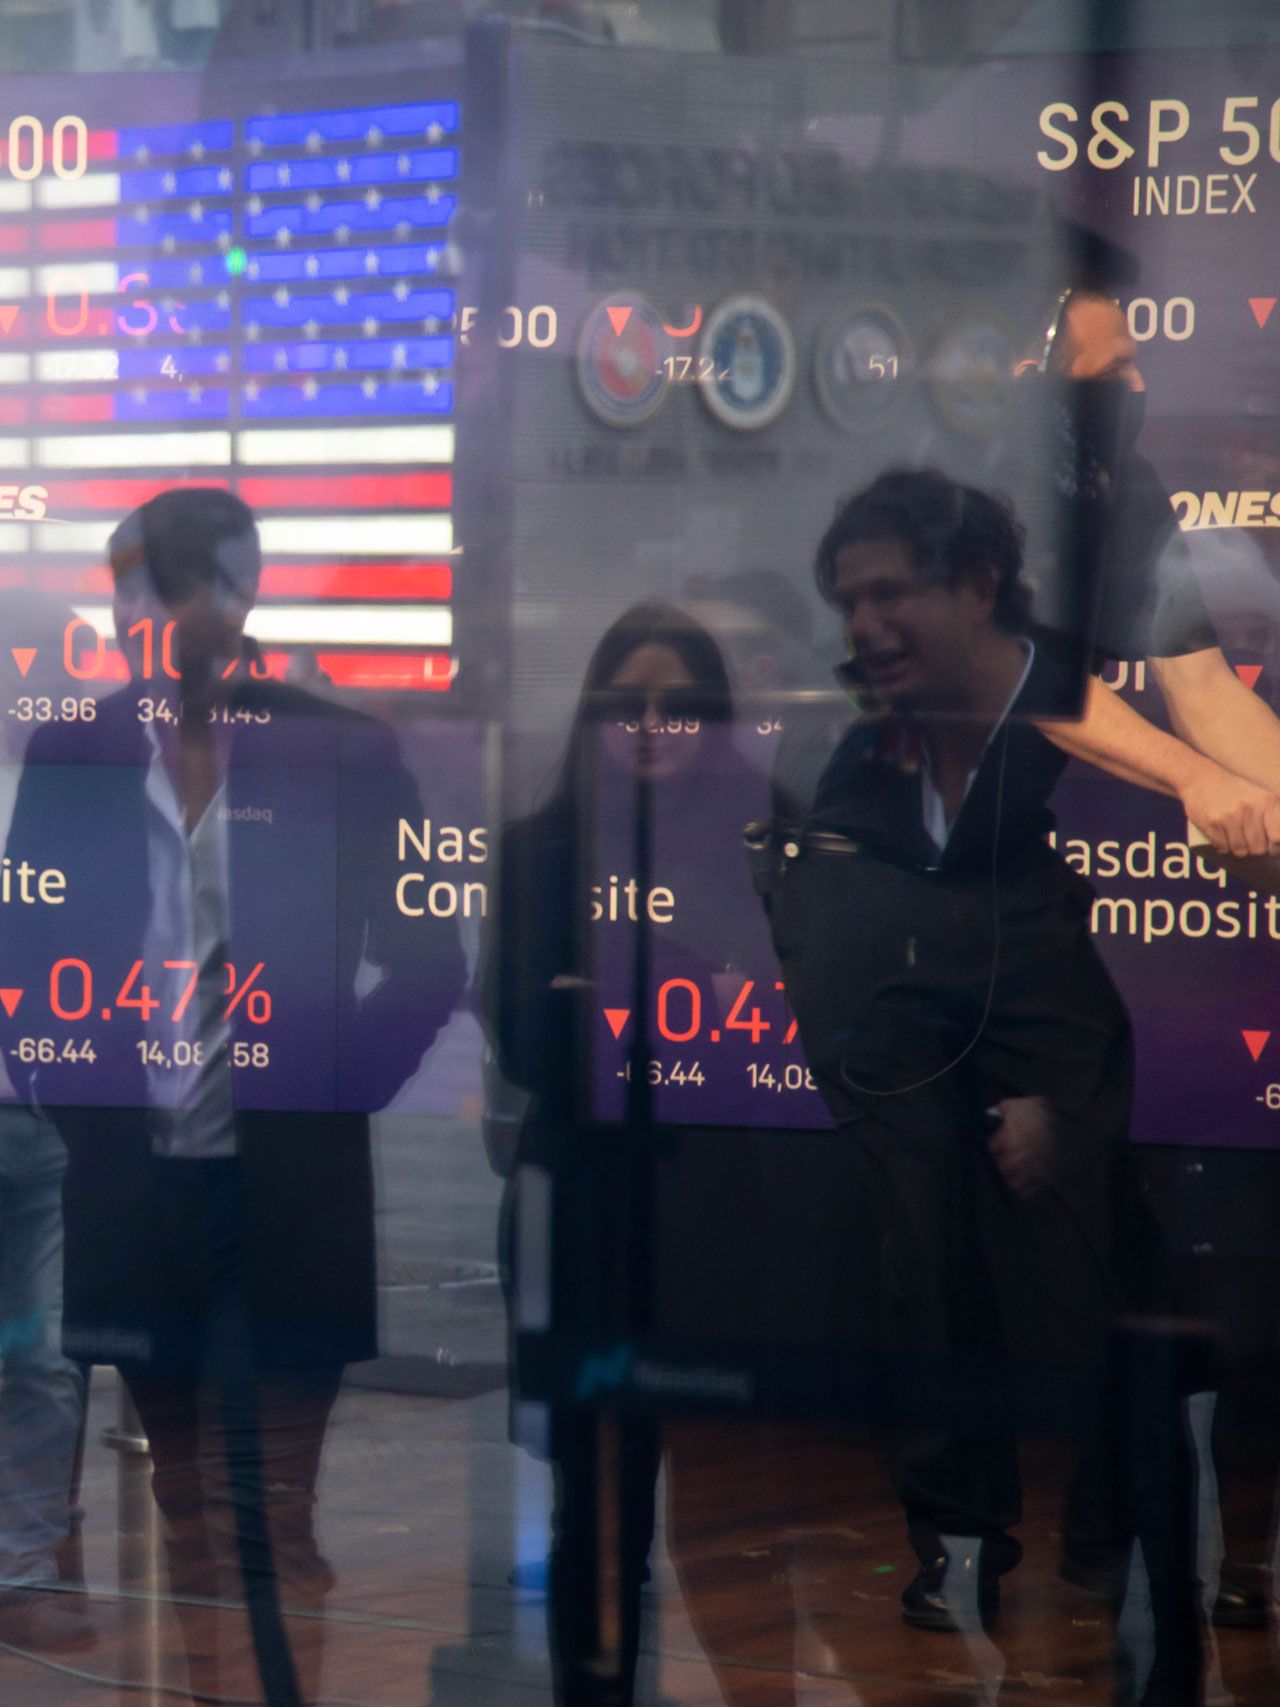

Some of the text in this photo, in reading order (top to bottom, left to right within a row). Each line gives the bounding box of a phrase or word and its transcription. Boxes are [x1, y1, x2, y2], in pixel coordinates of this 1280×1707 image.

[1037, 100, 1190, 171] S&P
[1132, 173, 1258, 216] INDEX
[8, 697, 97, 722] -33.96
[1049, 831, 1227, 888] asdaq
[49, 958, 271, 1024] 0.47%
[10, 1038, 97, 1063] -66.44
